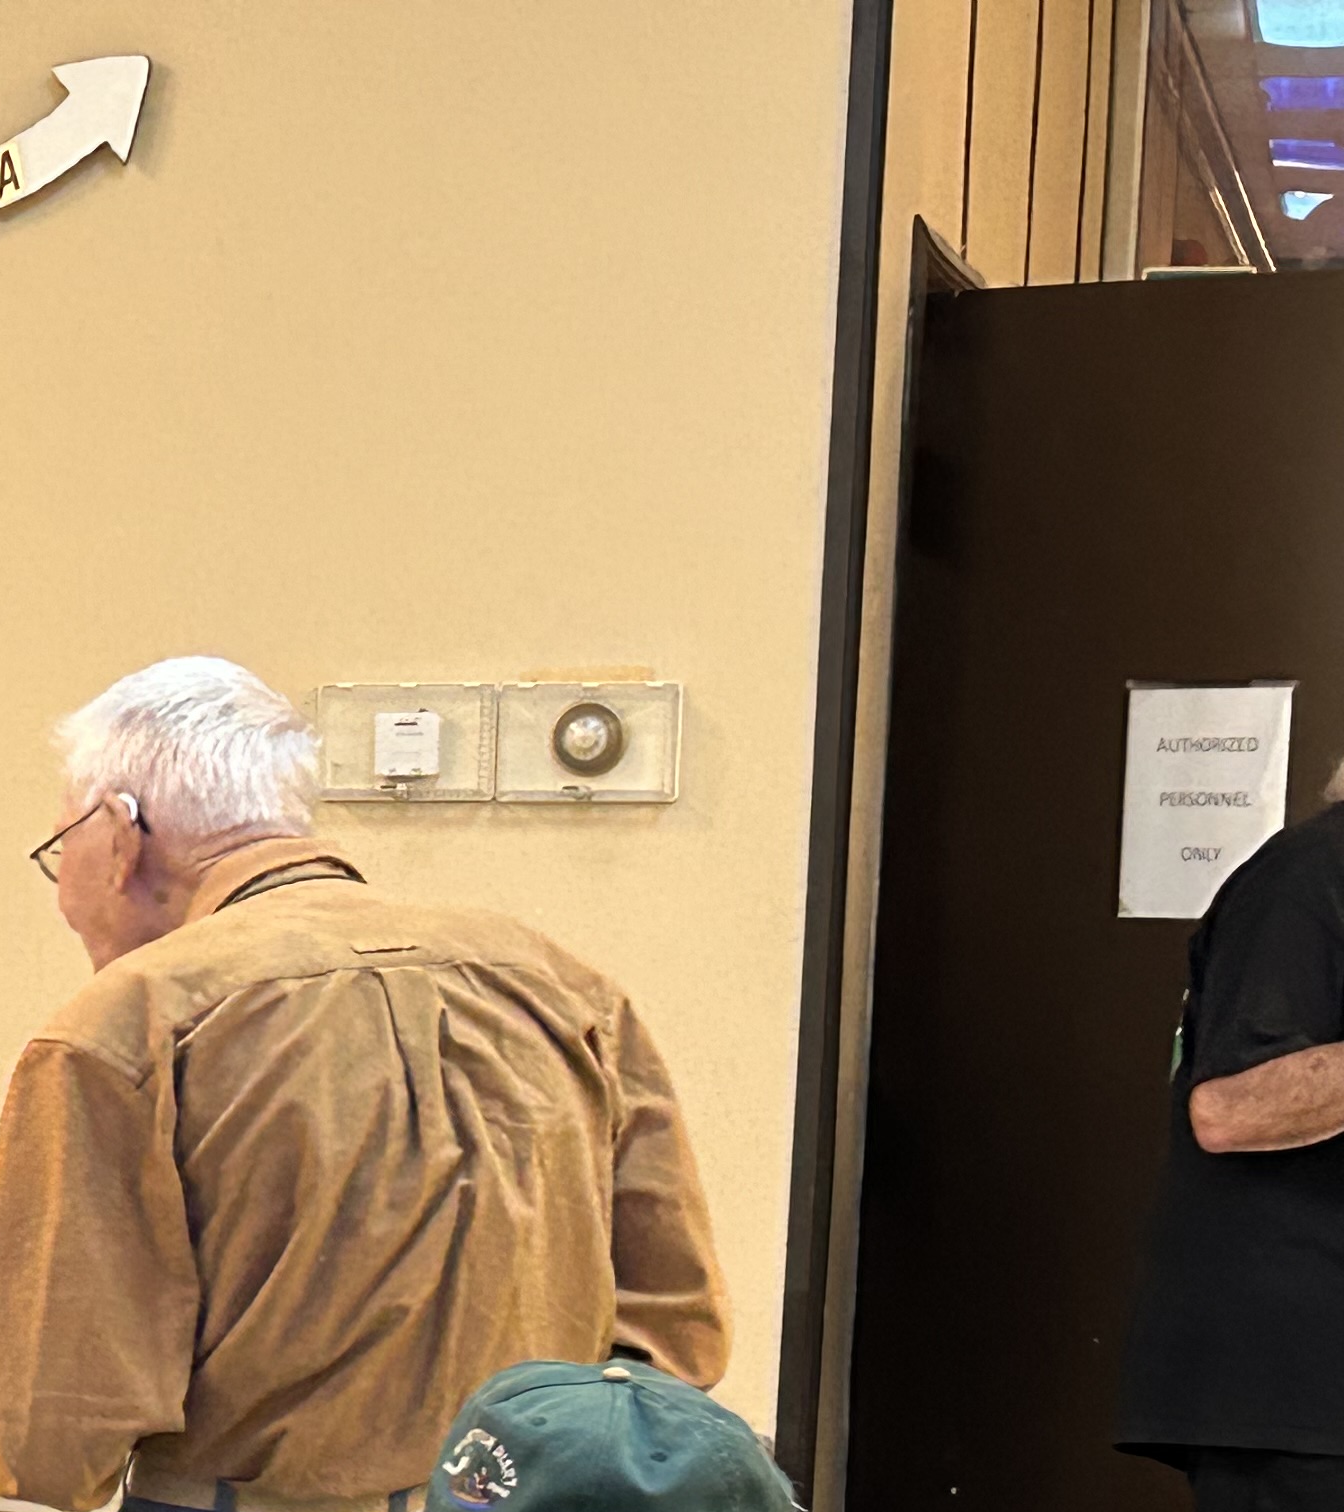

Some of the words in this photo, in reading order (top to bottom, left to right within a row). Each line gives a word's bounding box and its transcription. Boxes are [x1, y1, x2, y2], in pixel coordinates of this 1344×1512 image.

[1156, 737, 1259, 752] AUTHORIZED
[1159, 791, 1252, 807] PERSONNEL
[1180, 847, 1222, 862] ONLY
